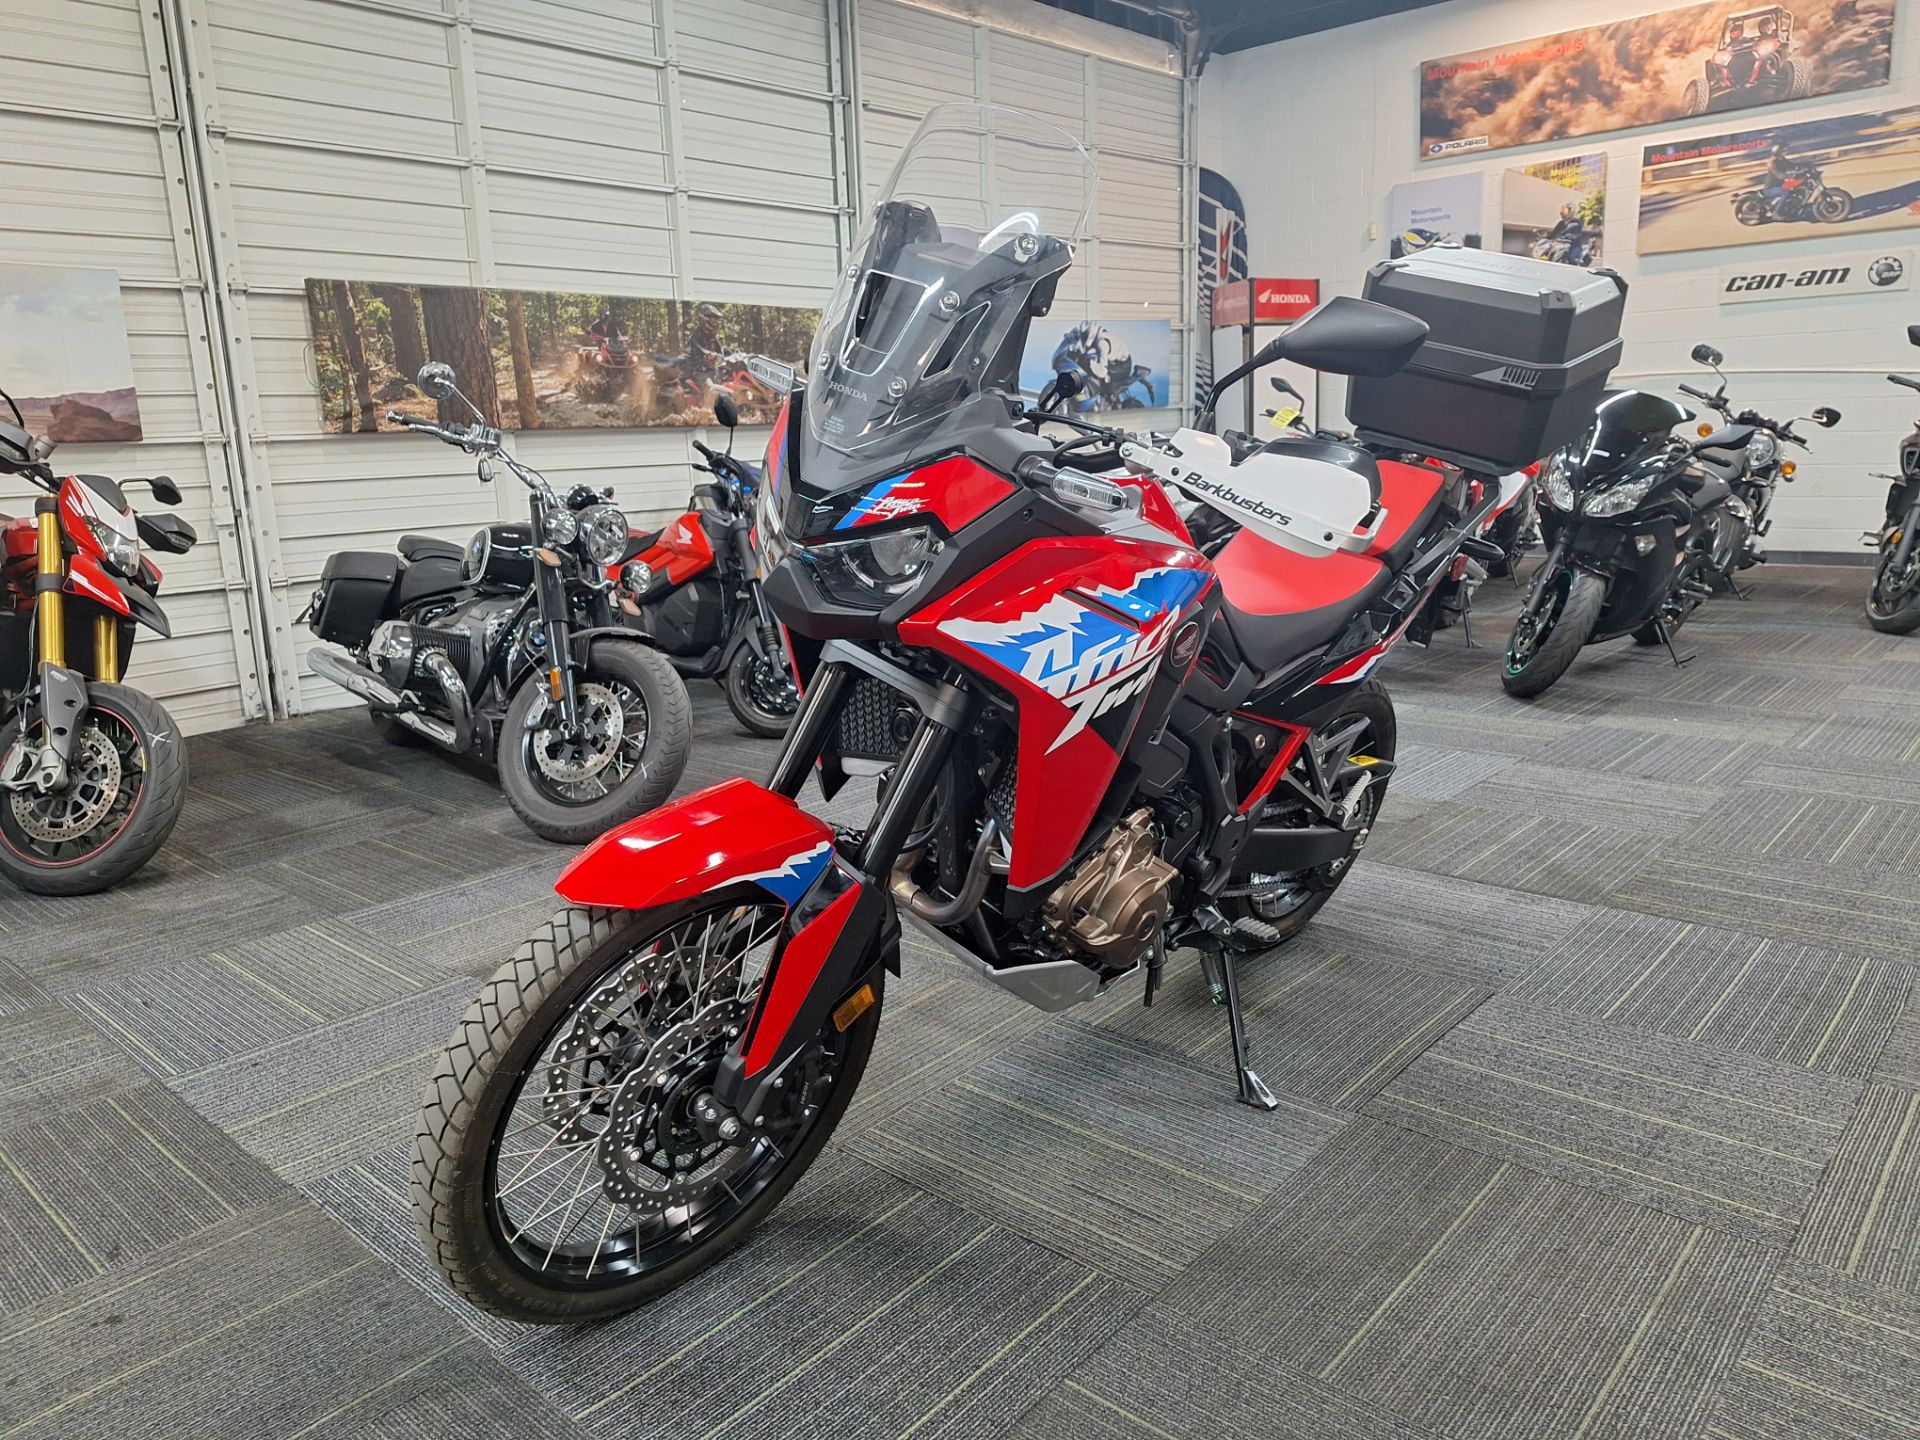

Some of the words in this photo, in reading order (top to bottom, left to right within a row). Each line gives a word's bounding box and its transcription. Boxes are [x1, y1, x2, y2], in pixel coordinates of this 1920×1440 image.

[1427, 59, 1490, 81] Mountain
[1495, 40, 1584, 66] Motorsports
[1445, 137, 1488, 150] POLARIS
[1651, 149, 1699, 163] Mountain
[1701, 139, 1769, 155] Motorsports
[1411, 206, 1442, 216] Mountain
[1411, 214, 1452, 224] Motorsports
[1725, 266, 1851, 292] can-am
[1271, 294, 1311, 304] HONDA
[828, 380, 868, 402] HONDA
[1182, 471, 1293, 526] Barkbusters
[1020, 603, 1181, 700] Africa
